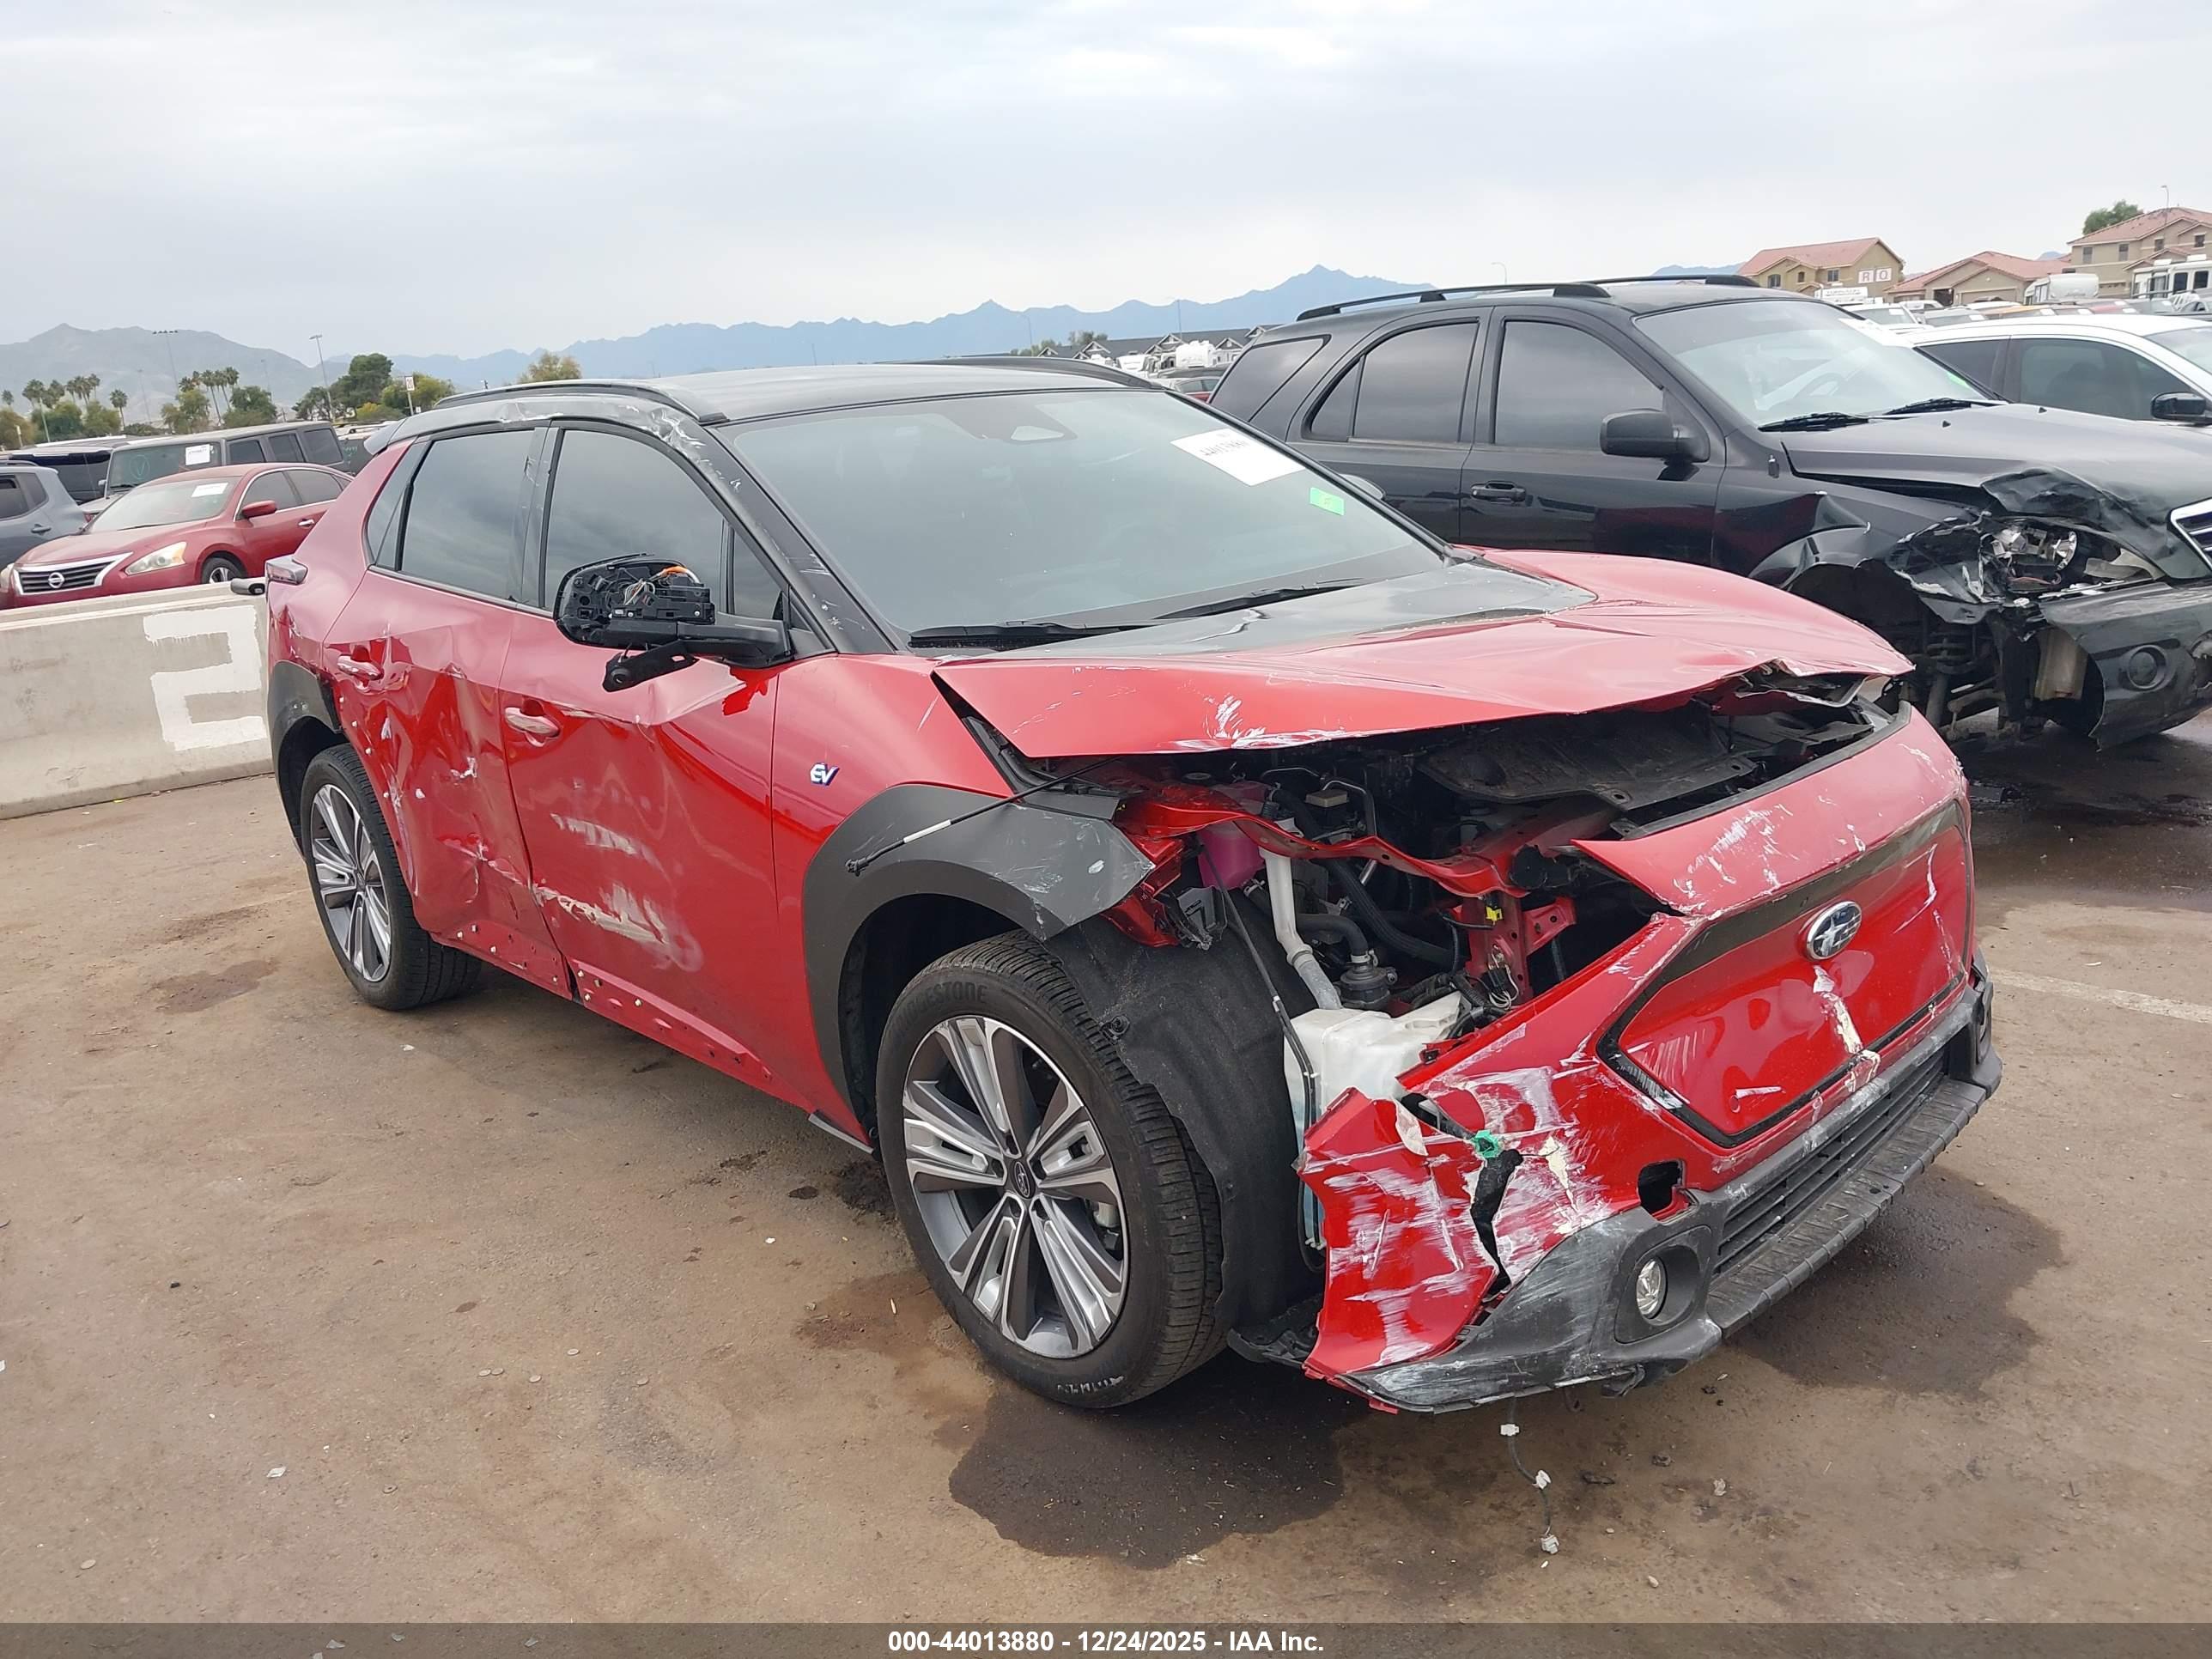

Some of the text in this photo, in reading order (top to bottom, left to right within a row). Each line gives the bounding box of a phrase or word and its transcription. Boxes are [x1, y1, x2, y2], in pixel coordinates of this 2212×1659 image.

[143, 605, 269, 751] 2
[810, 762, 841, 787] EV
[890, 981, 988, 1041] RIDGESTONE
